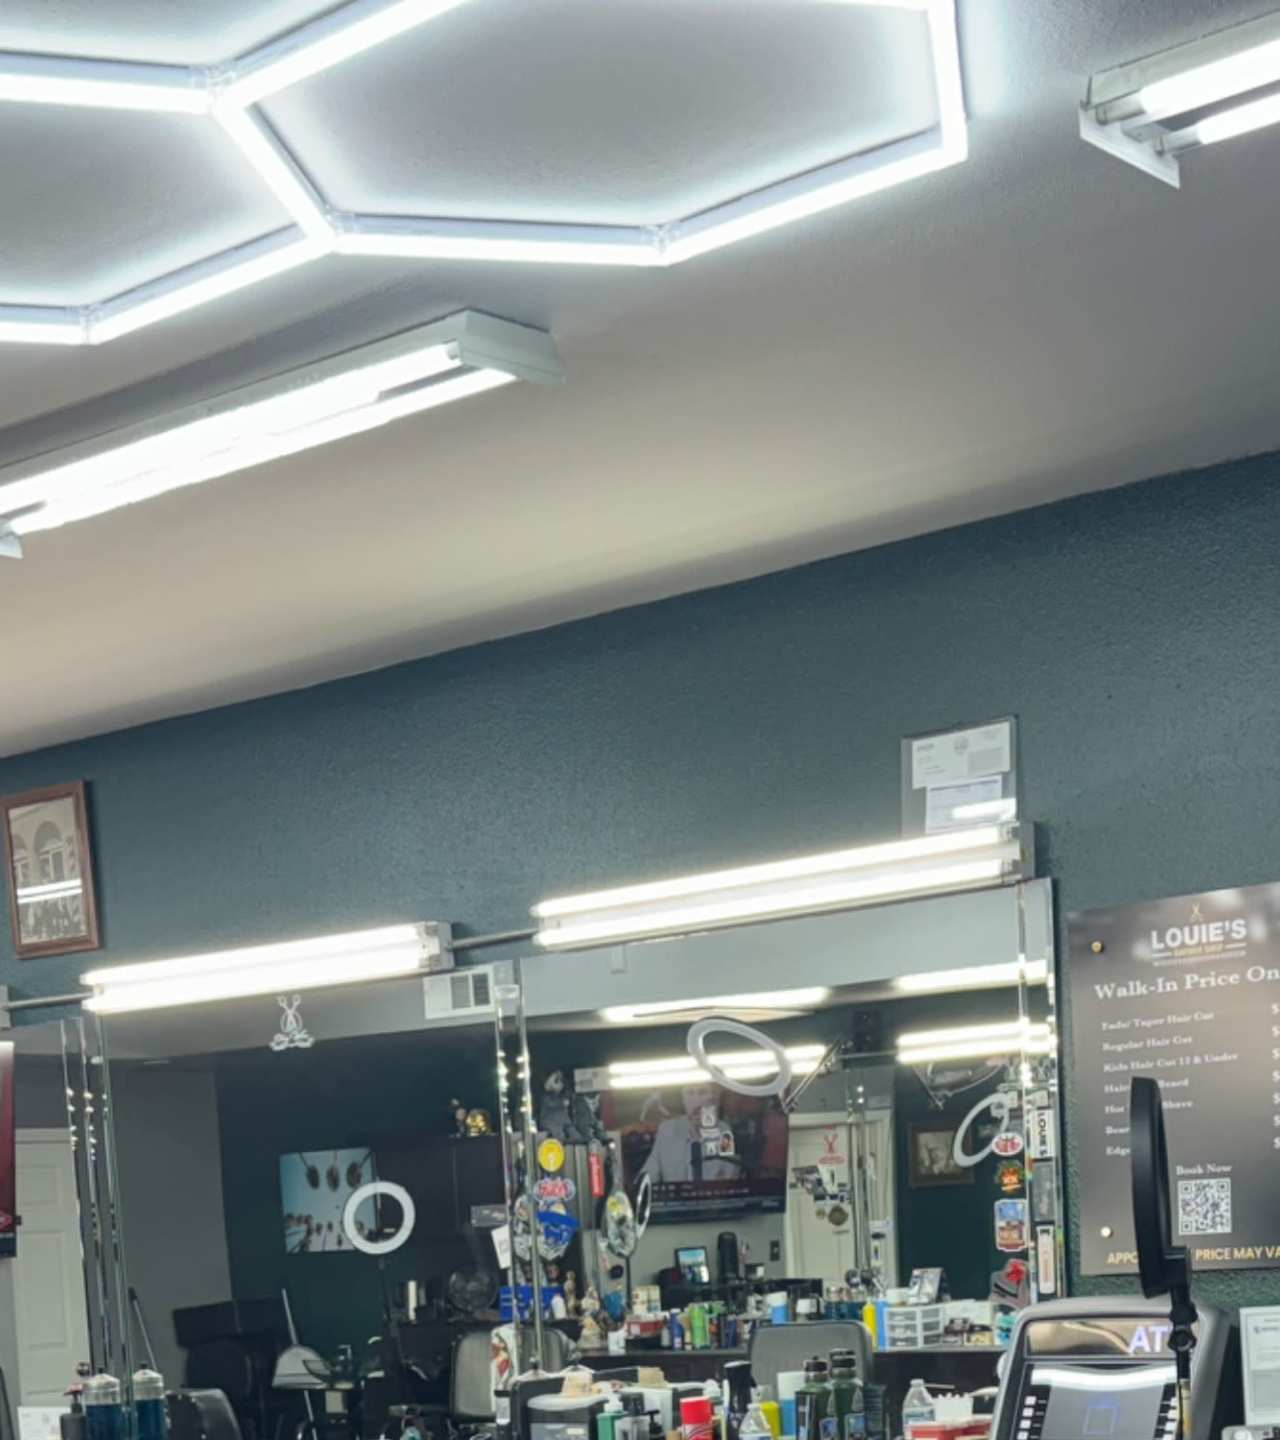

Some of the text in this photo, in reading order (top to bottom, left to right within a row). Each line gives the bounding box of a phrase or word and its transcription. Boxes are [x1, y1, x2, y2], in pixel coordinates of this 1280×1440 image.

[1151, 919, 1247, 950] LOUIE'S
[1094, 976, 1178, 1000] Walk-In
[1184, 971, 1240, 990] Price
[1167, 1014, 1191, 1024] Hair
[1146, 1037, 1170, 1047] Hair
[1176, 1163, 1232, 1175] Book Now
[1195, 1249, 1231, 1261] PRICE
[1234, 1247, 1264, 1260] MAY
[1129, 1325, 1169, 1354] AT
